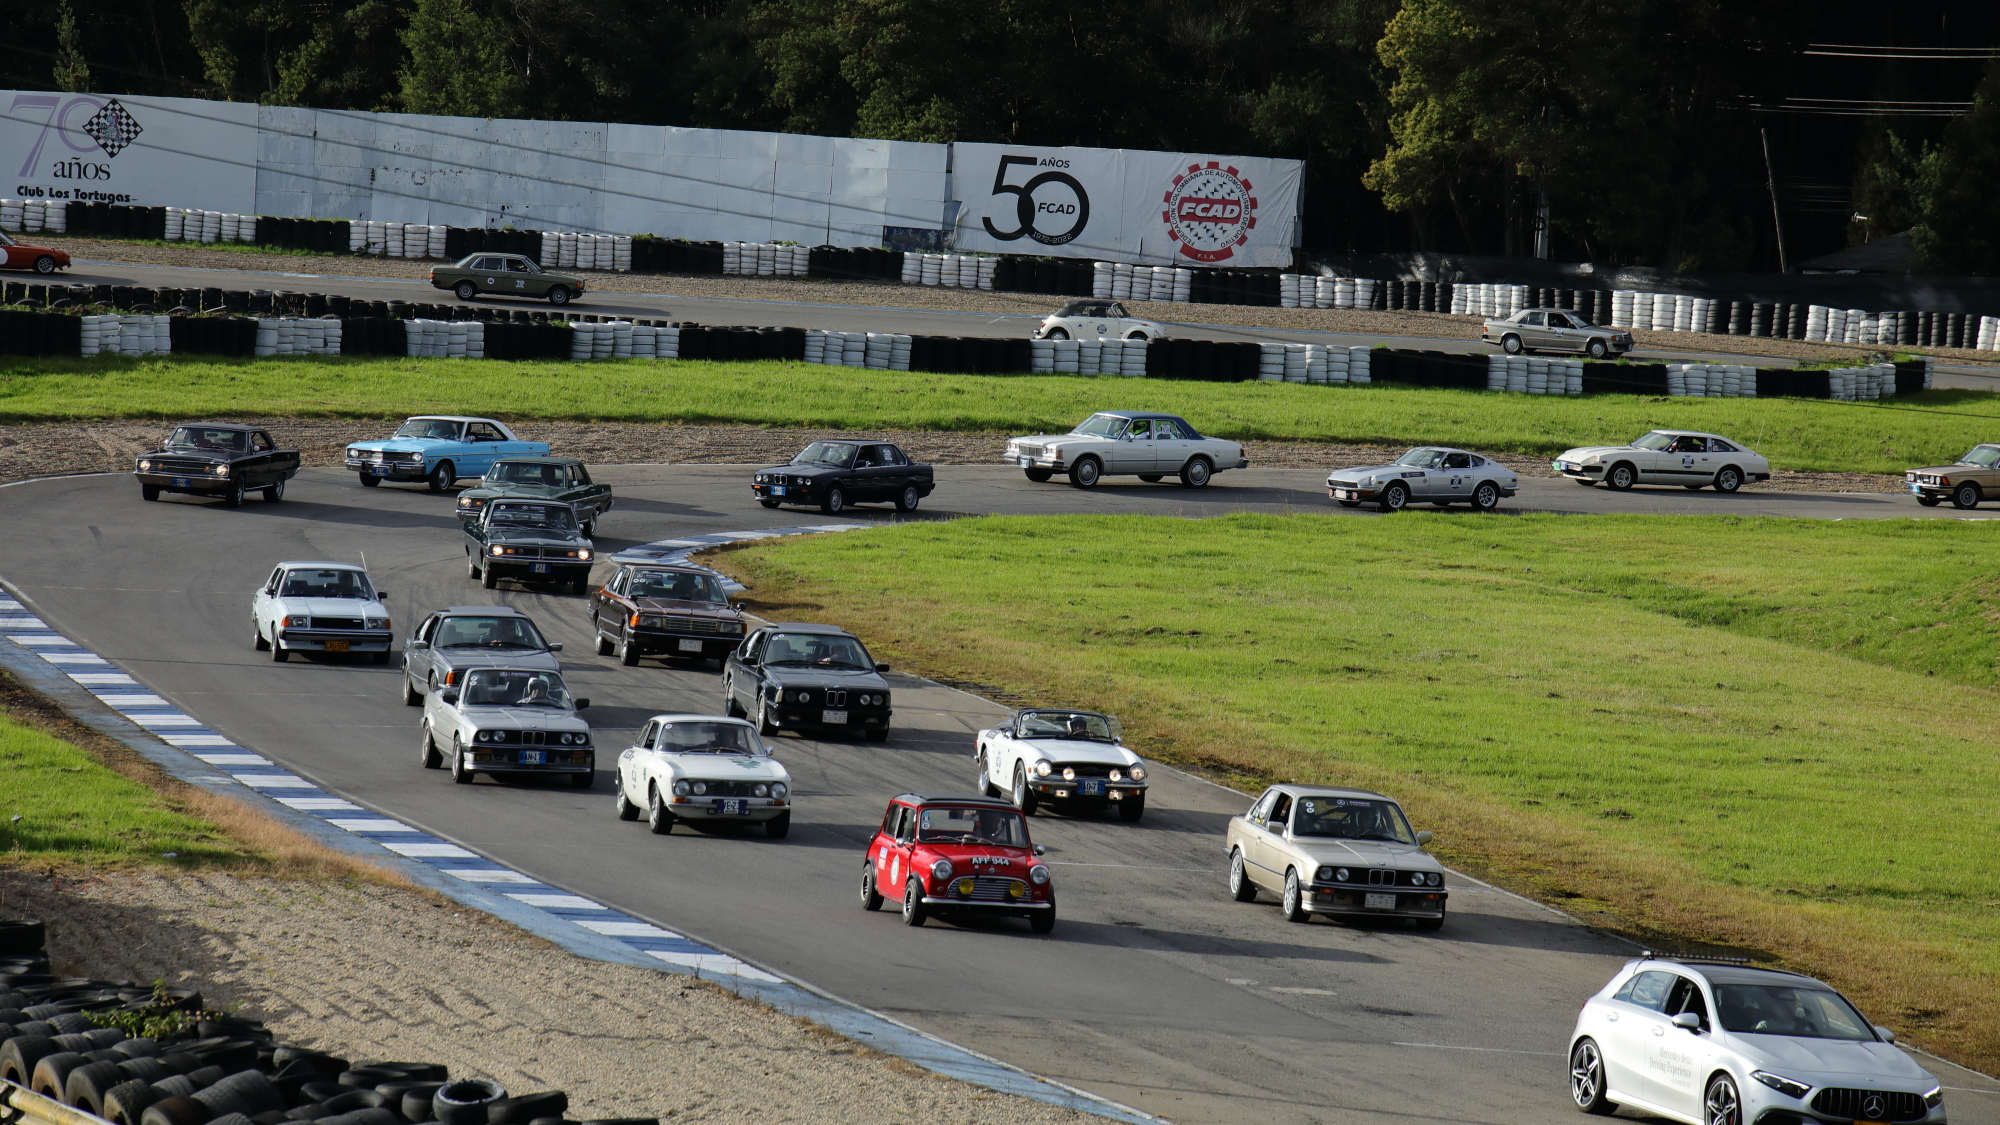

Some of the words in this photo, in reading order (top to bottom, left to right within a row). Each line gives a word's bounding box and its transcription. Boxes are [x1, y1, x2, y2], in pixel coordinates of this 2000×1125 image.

[9, 95, 105, 177] 70
[53, 156, 111, 181] años
[1039, 157, 1071, 169] AÑOS
[17, 185, 44, 198] Club
[49, 187, 70, 199] Los
[74, 188, 131, 204] Tortugas
[982, 154, 1090, 246] 50
[1170, 171, 1204, 206] COLOMBIANA
[1215, 170, 1250, 216] AUTOMOVILISMO
[1037, 202, 1076, 215] FCAD
[1179, 202, 1241, 220] FCAD
[1032, 231, 1073, 244] 1972-2022
[1220, 217, 1249, 249] DEPORTIVO
[972, 857, 990, 865] AFF
[991, 857, 1010, 867] 944
[1649, 1056, 1666, 1075] Driving
[1666, 1061, 1692, 1079] Experience
